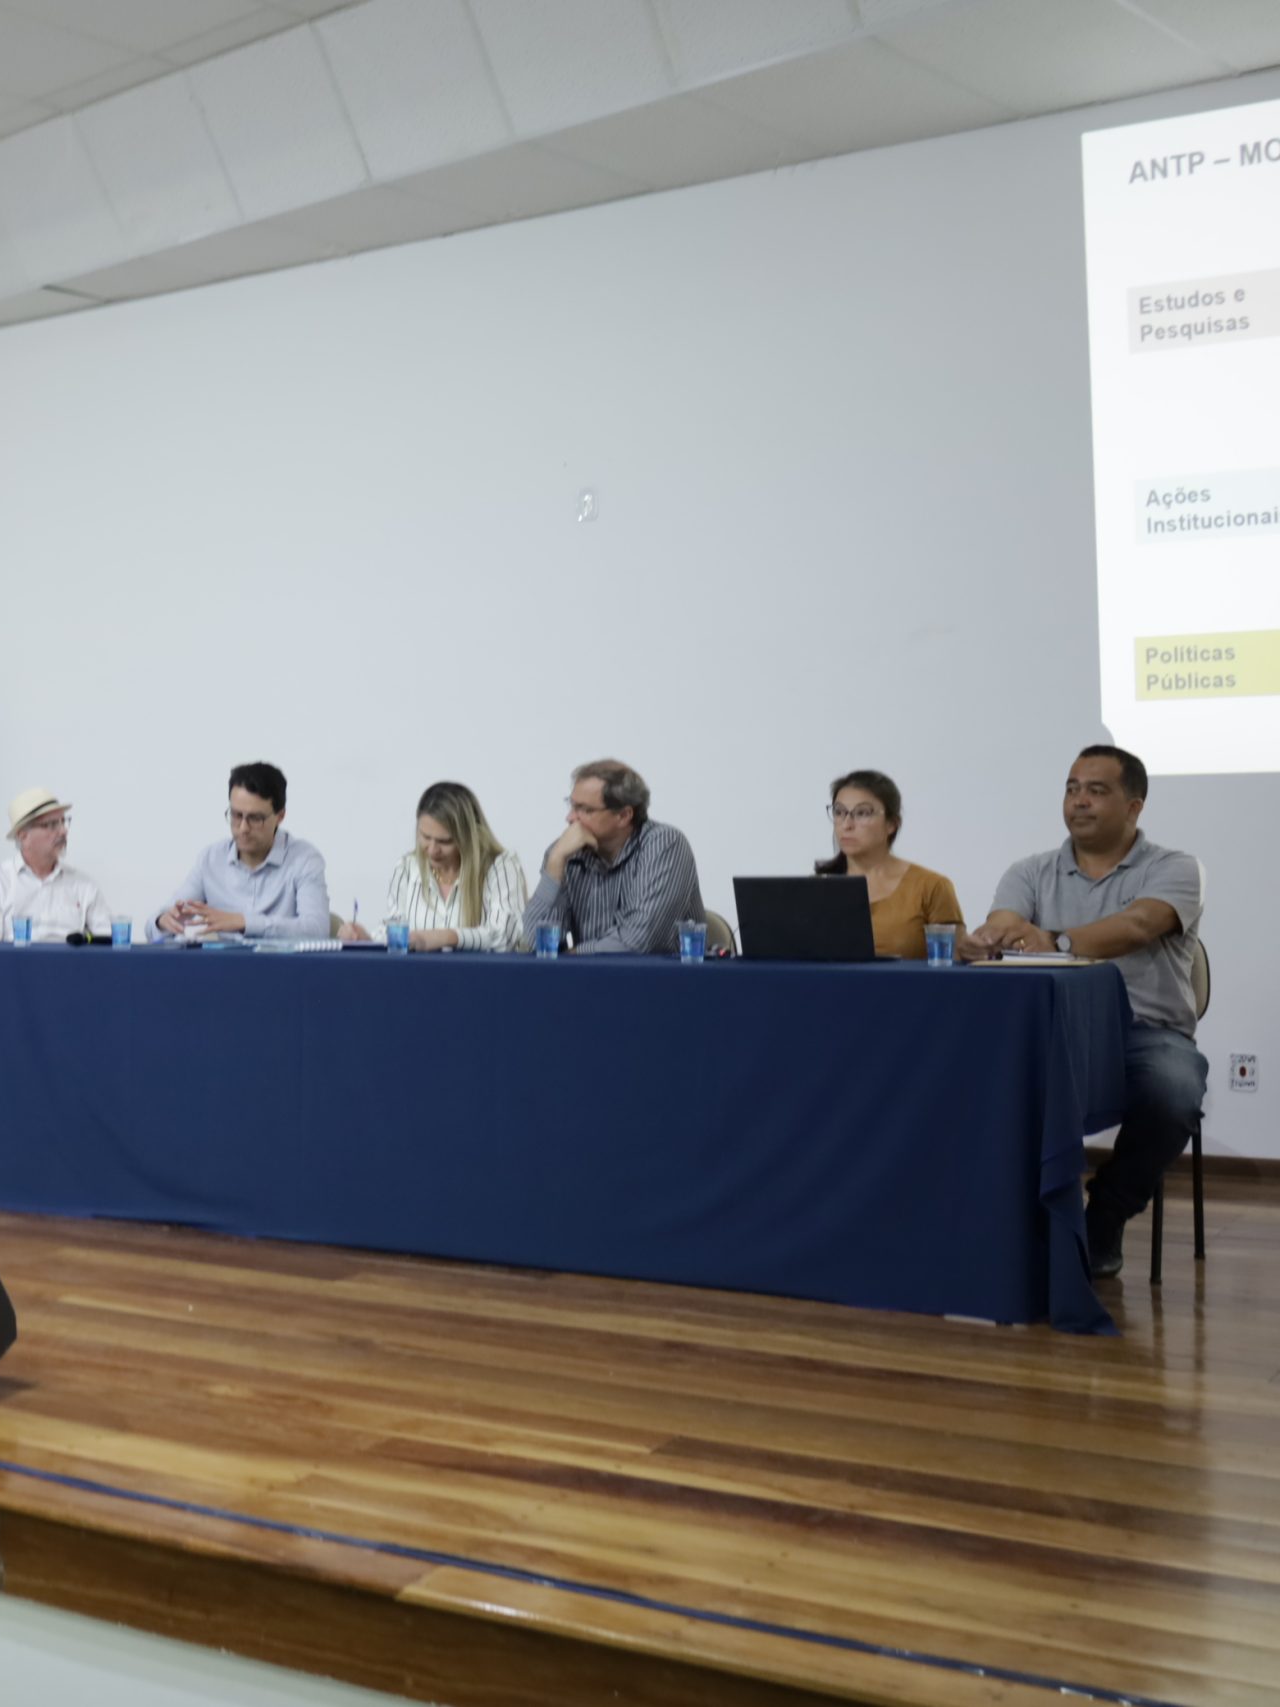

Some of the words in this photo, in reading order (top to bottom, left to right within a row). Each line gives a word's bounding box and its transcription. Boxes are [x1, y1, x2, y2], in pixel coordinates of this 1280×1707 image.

[1128, 150, 1205, 184] ANTP
[1139, 289, 1226, 315] Estudos
[1233, 288, 1245, 302] e
[1140, 315, 1250, 342] Pesquisas
[1145, 486, 1211, 510] Ações
[1146, 506, 1280, 534] Institucionai
[1145, 645, 1236, 664] Políticas
[1146, 671, 1237, 691] Públicas
